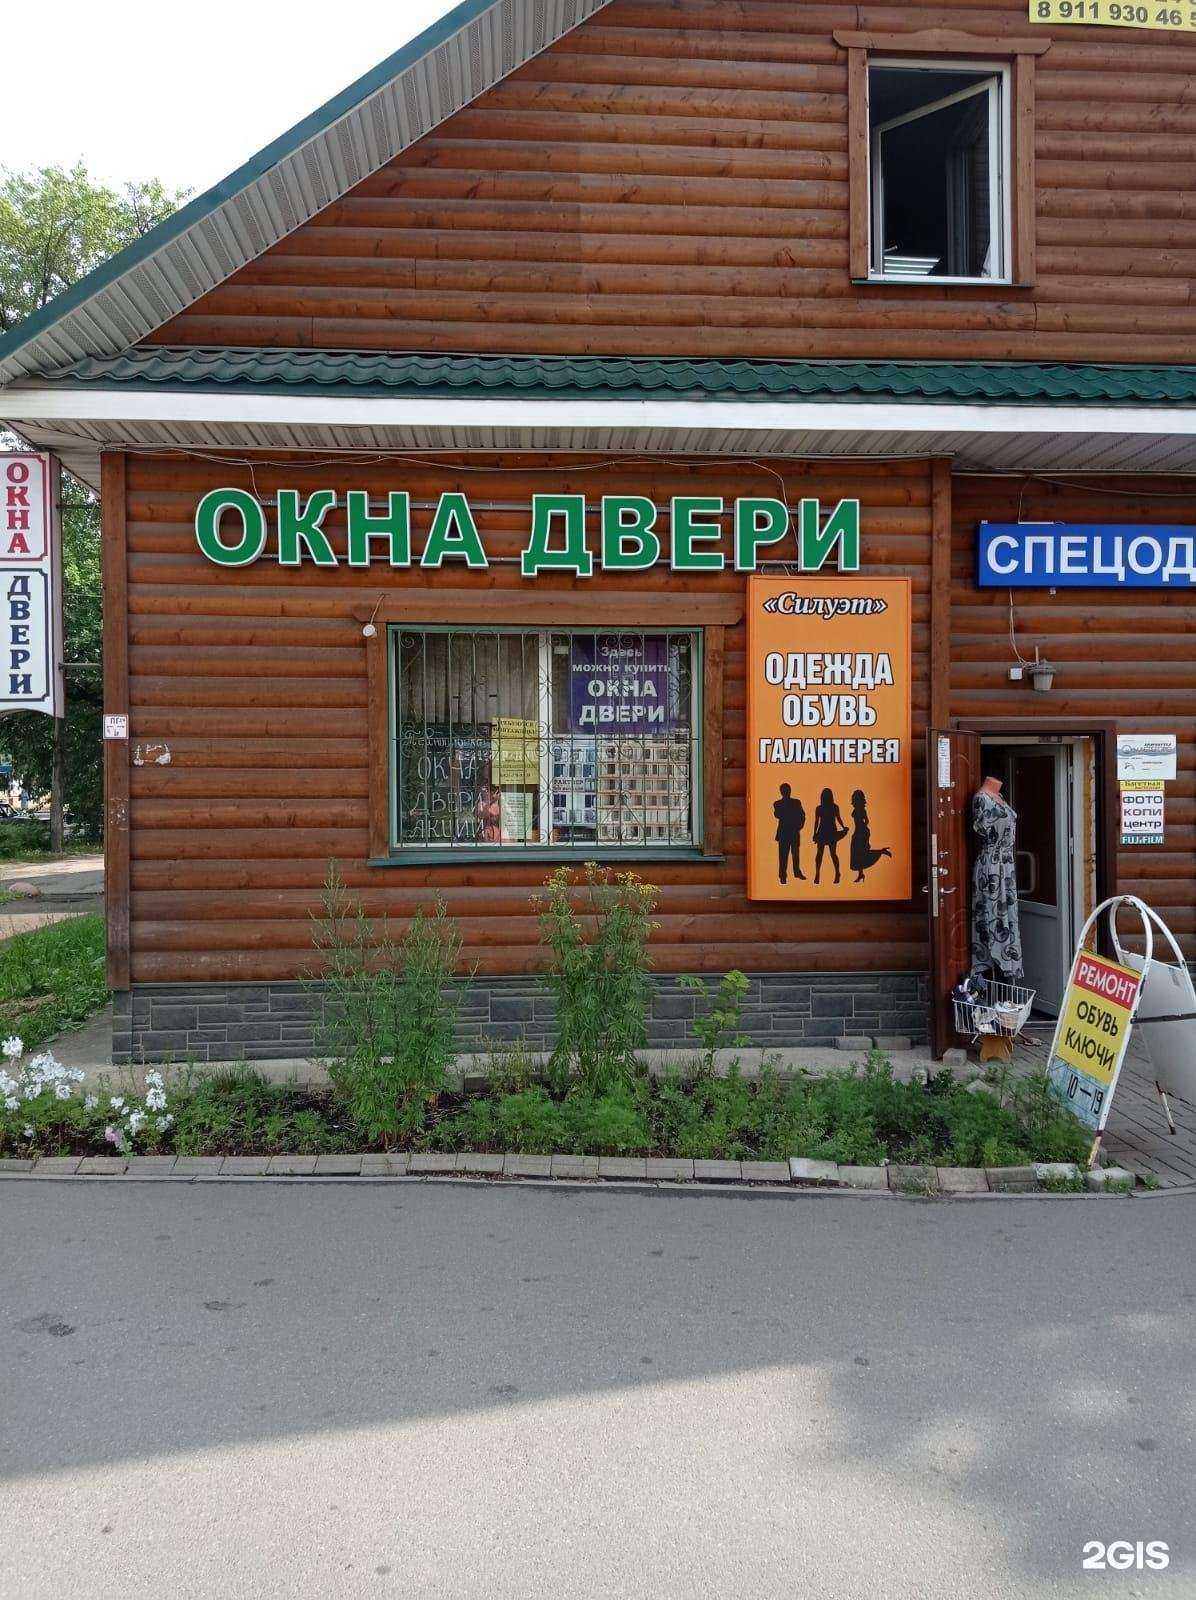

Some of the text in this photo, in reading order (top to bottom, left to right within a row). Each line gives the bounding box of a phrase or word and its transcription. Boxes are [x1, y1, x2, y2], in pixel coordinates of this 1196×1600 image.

[1037, 1, 1051, 18] 8
[1059, 1, 1099, 19] 911
[1109, 3, 1149, 23] 930
[1155, 8, 1183, 25] 46
[6, 462, 30, 553] ОКНА
[195, 487, 862, 578] ОКНА ДВЕРИ
[986, 535, 1196, 582] СПЕЦОД
[763, 591, 888, 619] «Силуэт»
[7, 575, 33, 694] ДВЕРИ
[602, 646, 643, 658] Здесь
[572, 664, 672, 675] можно купить
[764, 652, 894, 690] ОДЕЖДА
[587, 679, 658, 697] ОКНА
[579, 705, 665, 726] ДВЕРИ
[781, 693, 877, 727] ОБУВЬ
[758, 737, 901, 764] ГАЛАНТЕРЕЯ
[417, 755, 479, 780] ОКНА
[410, 791, 484, 816] ДВЕРИ
[1122, 795, 1163, 805] ФОТО
[1123, 821, 1162, 829] центр
[1077, 962, 1137, 1003] РЕМОНТ
[1076, 1001, 1119, 1037] ОБУВЬ
[1065, 1027, 1115, 1071] КЛЮЧИ
